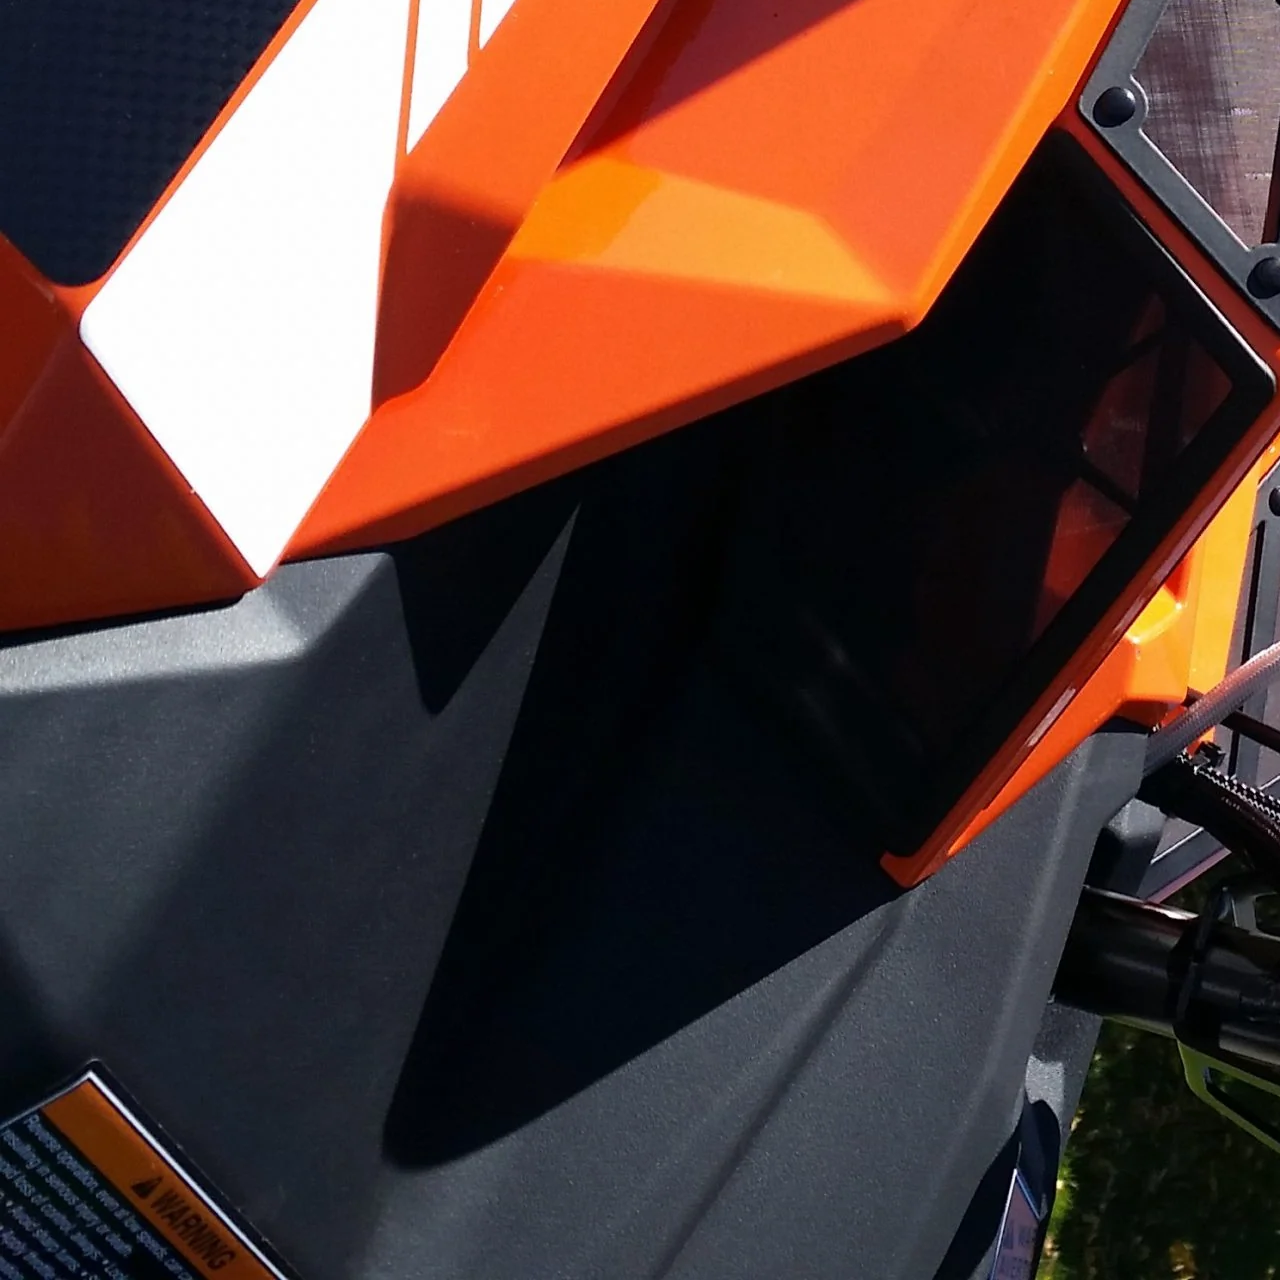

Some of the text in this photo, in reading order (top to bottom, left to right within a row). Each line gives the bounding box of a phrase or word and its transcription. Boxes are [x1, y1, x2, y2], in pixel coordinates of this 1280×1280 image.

[23, 1114, 61, 1153] Reverse
[57, 1150, 99, 1193] operation,
[96, 1189, 120, 1211] even
[124, 1214, 141, 1233] low
[45, 1174, 80, 1206] serious
[75, 1201, 102, 1228] injury
[8, 1206, 41, 1231] Avoid
[32, 1229, 60, 1252] sharp
[14, 1175, 36, 1197] loss
[41, 1203, 77, 1236] control,
[150, 1187, 236, 1271] WARNING
[0, 1230, 27, 1256] Apply
